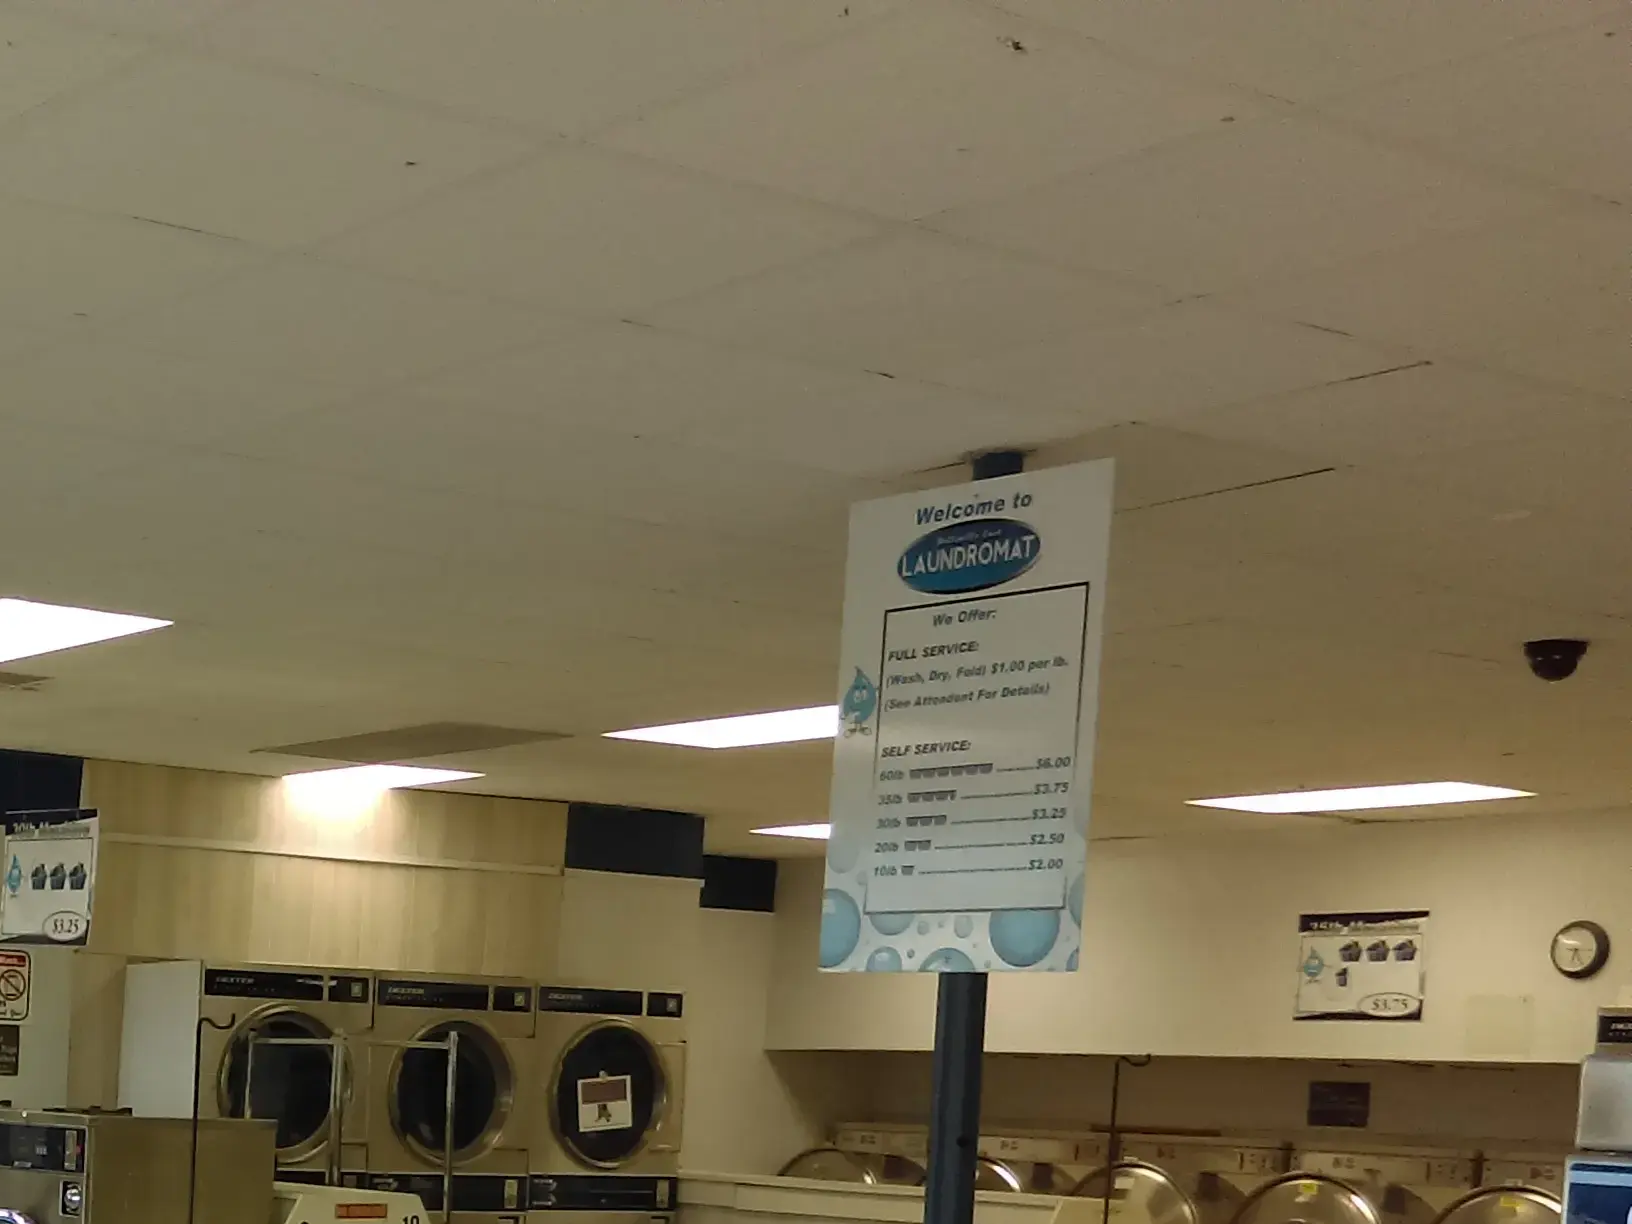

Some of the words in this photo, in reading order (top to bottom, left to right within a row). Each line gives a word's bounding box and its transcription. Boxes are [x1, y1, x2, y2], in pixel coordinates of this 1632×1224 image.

[916, 497, 1006, 525] Welcome
[1013, 492, 1033, 509] to
[901, 535, 1036, 577] LAUNDROMAT
[933, 614, 952, 627] We
[958, 609, 997, 623] Offer:
[888, 649, 917, 662] FULL
[921, 641, 980, 658] SERVICE:
[990, 660, 1025, 674] $1.00
[1028, 658, 1050, 673] per
[977, 686, 998, 700] For
[881, 744, 911, 758] SELF
[914, 740, 972, 754] SERVICE:
[1036, 756, 1072, 769] $6.00
[1030, 833, 1065, 845] $2.50
[1028, 859, 1064, 870] $2.00
[52, 918, 80, 934] $3.25
